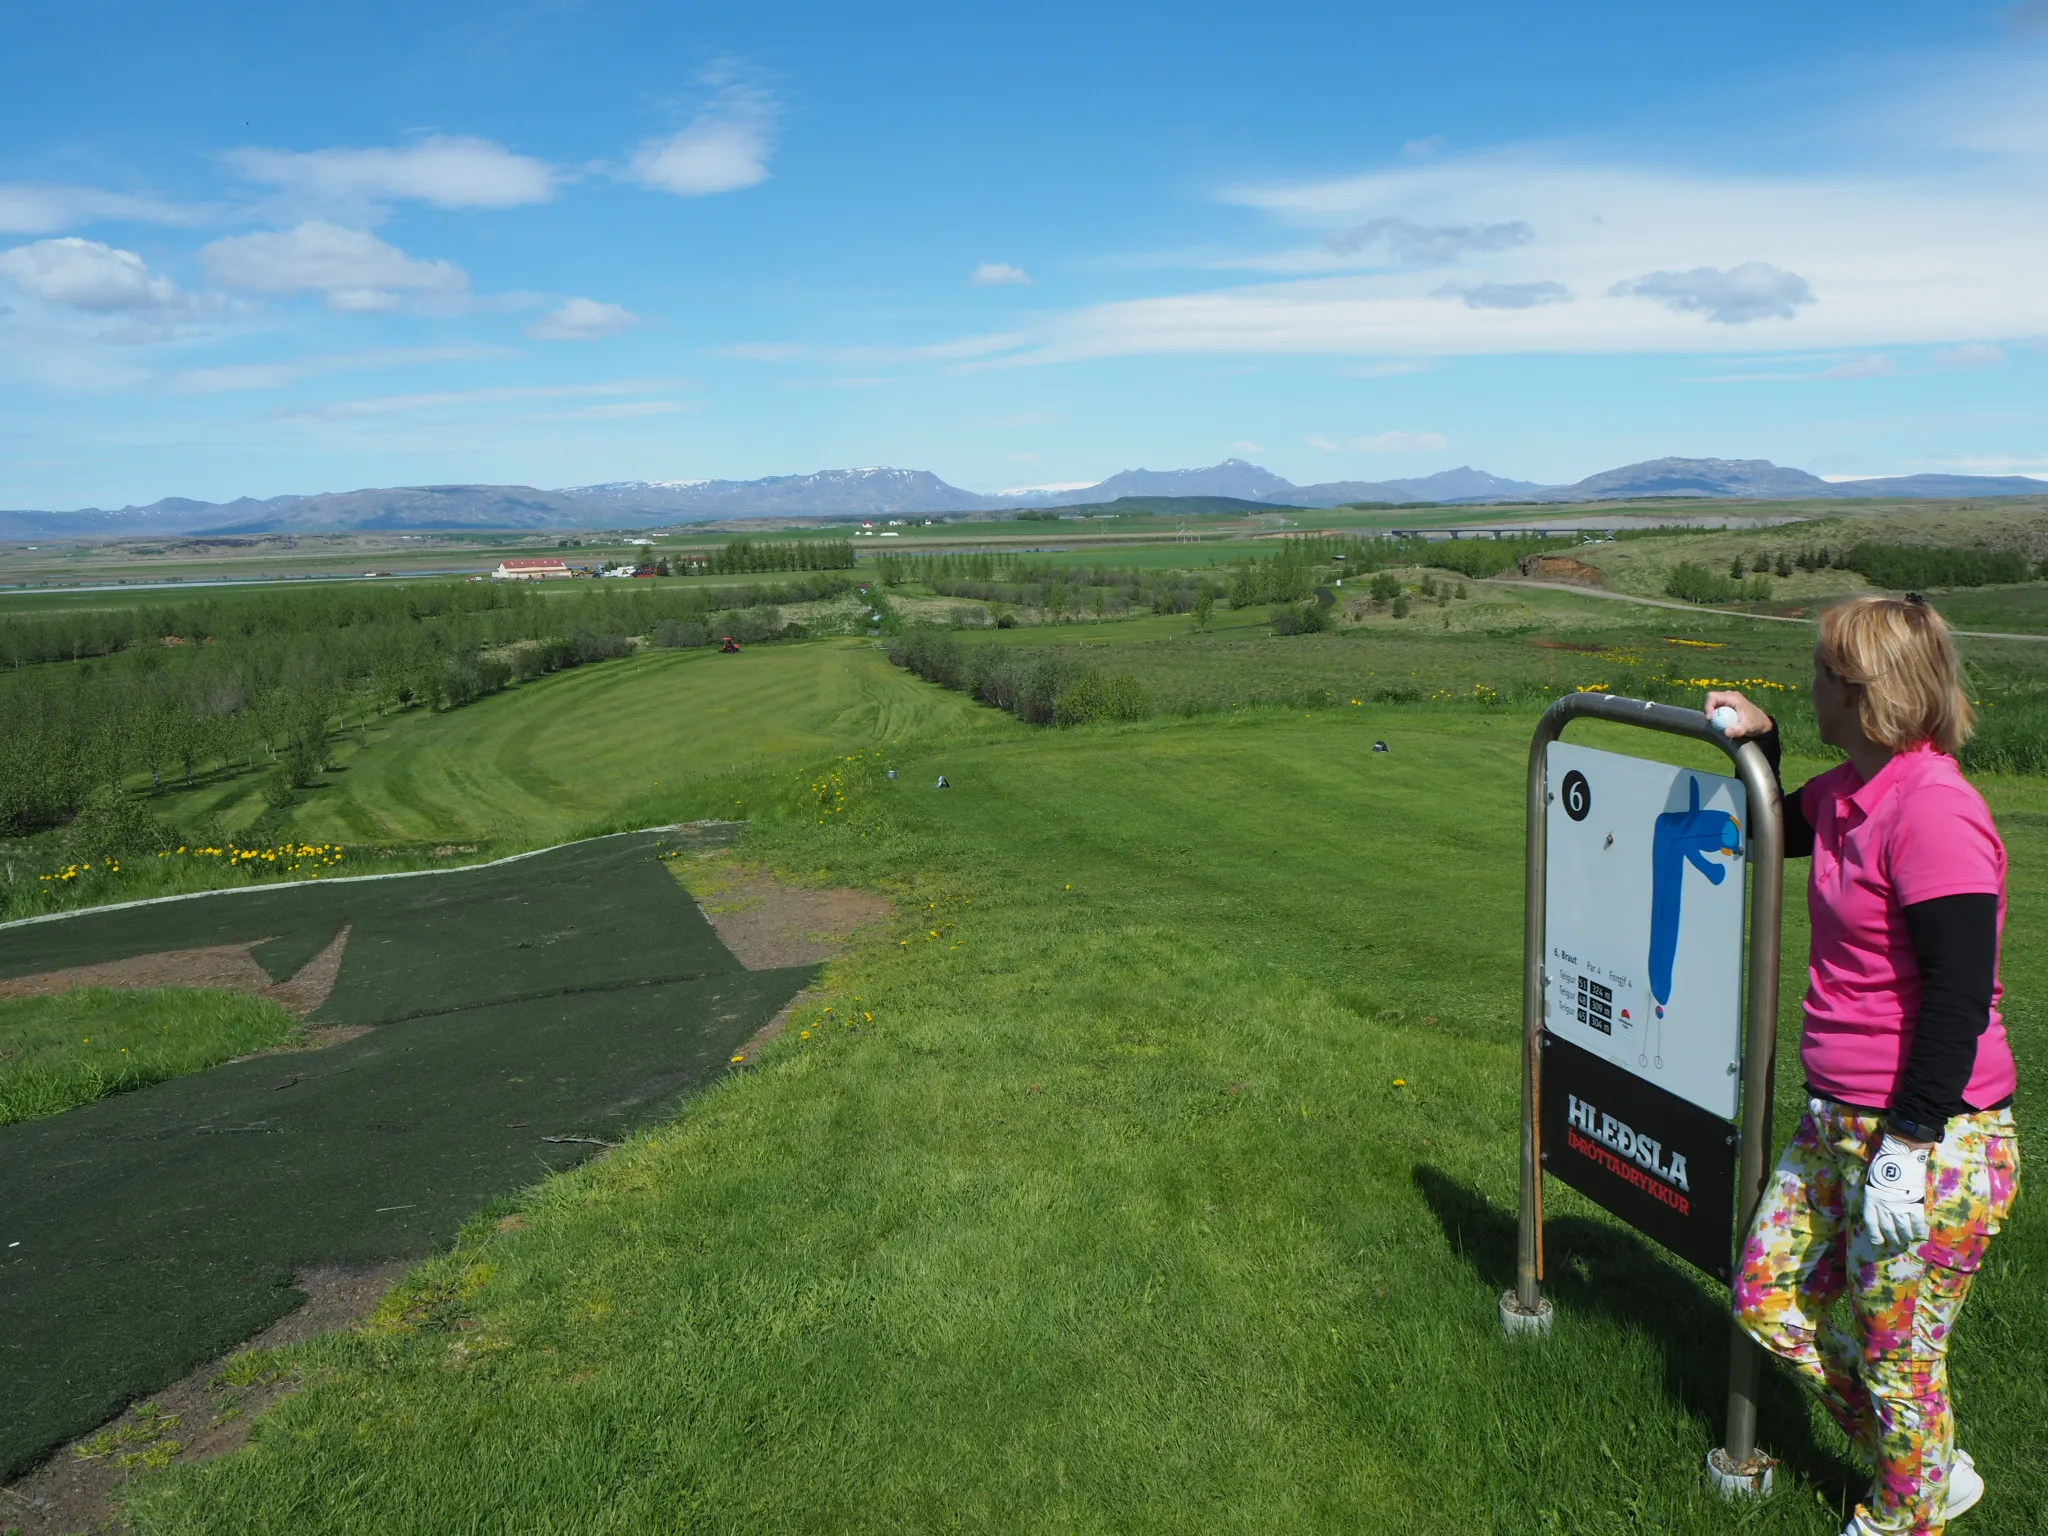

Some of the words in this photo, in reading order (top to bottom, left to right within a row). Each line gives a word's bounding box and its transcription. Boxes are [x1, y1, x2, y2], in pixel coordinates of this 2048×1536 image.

[1569, 781, 1583, 811] 6
[1554, 948, 1560, 958] 6.
[1561, 951, 1577, 965] Braut
[1586, 961, 1596, 972] Par
[1597, 967, 1601, 975] 4
[1559, 969, 1576, 984] Teigur
[1579, 978, 1587, 989] 51
[1592, 985, 1603, 998] 324
[1604, 992, 1611, 1001] m
[1628, 980, 1632, 988] 4
[1559, 985, 1576, 1000] Teigur
[1578, 994, 1587, 1005] 48
[1591, 1001, 1603, 1013] 309
[1604, 1008, 1610, 1017] m
[1559, 1001, 1575, 1015] Teigur
[1578, 1011, 1586, 1021] 45
[1591, 1017, 1603, 1030] 304
[1603, 1024, 1610, 1033] m
[1885, 1165, 1897, 1178] FJ
